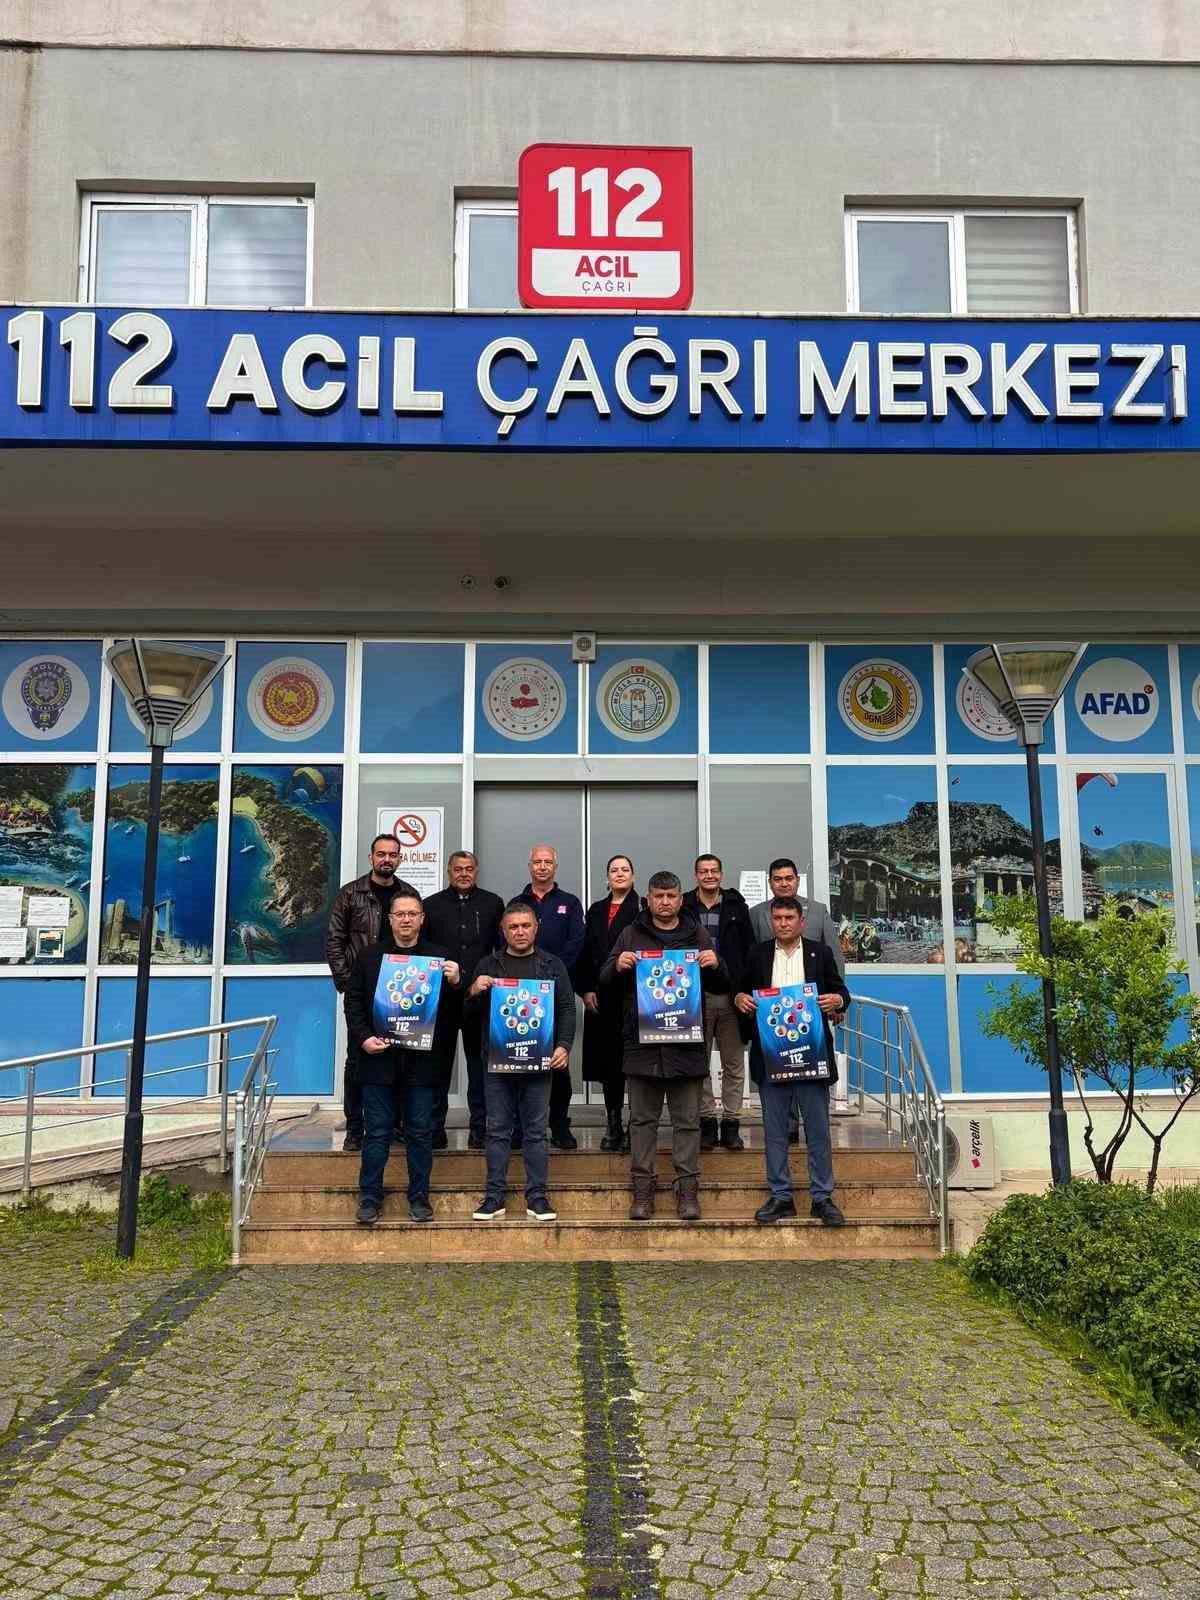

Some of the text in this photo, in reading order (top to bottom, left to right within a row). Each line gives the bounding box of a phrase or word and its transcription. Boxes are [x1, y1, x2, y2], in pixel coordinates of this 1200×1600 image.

[548, 167, 663, 238] 112
[582, 280, 631, 294] ÇAĞRI
[8, 311, 174, 409] 112
[476, 326, 767, 436] ÇAĞRI
[1081, 693, 1151, 715] AFAD
[395, 1021, 410, 1032] 112
[664, 1016, 678, 1027] 112
[514, 1046, 528, 1057] 112
[789, 1053, 804, 1064] 112
